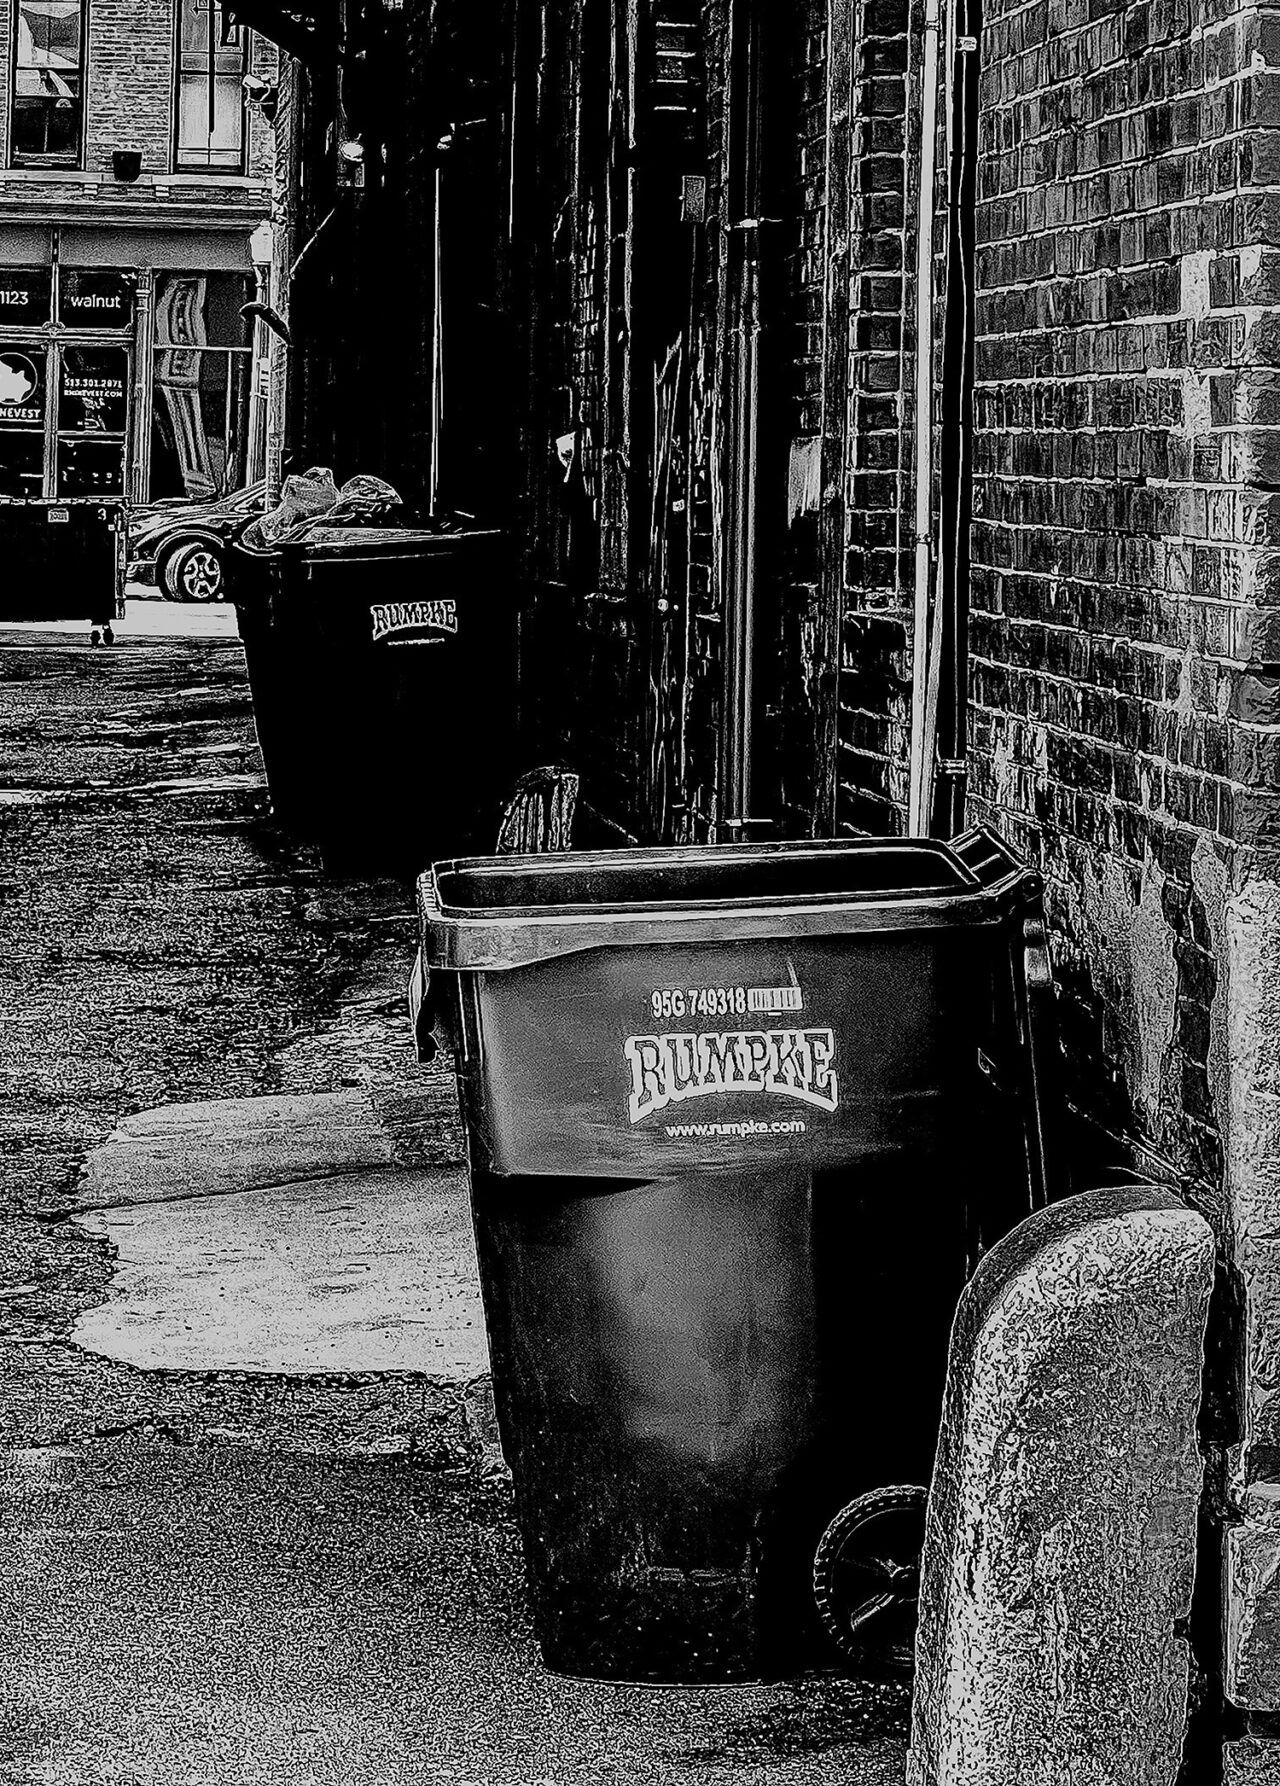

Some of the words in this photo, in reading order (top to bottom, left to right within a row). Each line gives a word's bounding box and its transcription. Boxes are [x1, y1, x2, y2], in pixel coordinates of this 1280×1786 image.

[0, 290, 29, 305] 1123
[70, 294, 121, 309] walnut
[370, 599, 458, 641] RUMPKE
[651, 988, 686, 1018] 95G
[687, 986, 747, 1017] 749318
[623, 1028, 839, 1125] RUMPKE
[665, 1119, 806, 1139] www.rumpke.com
